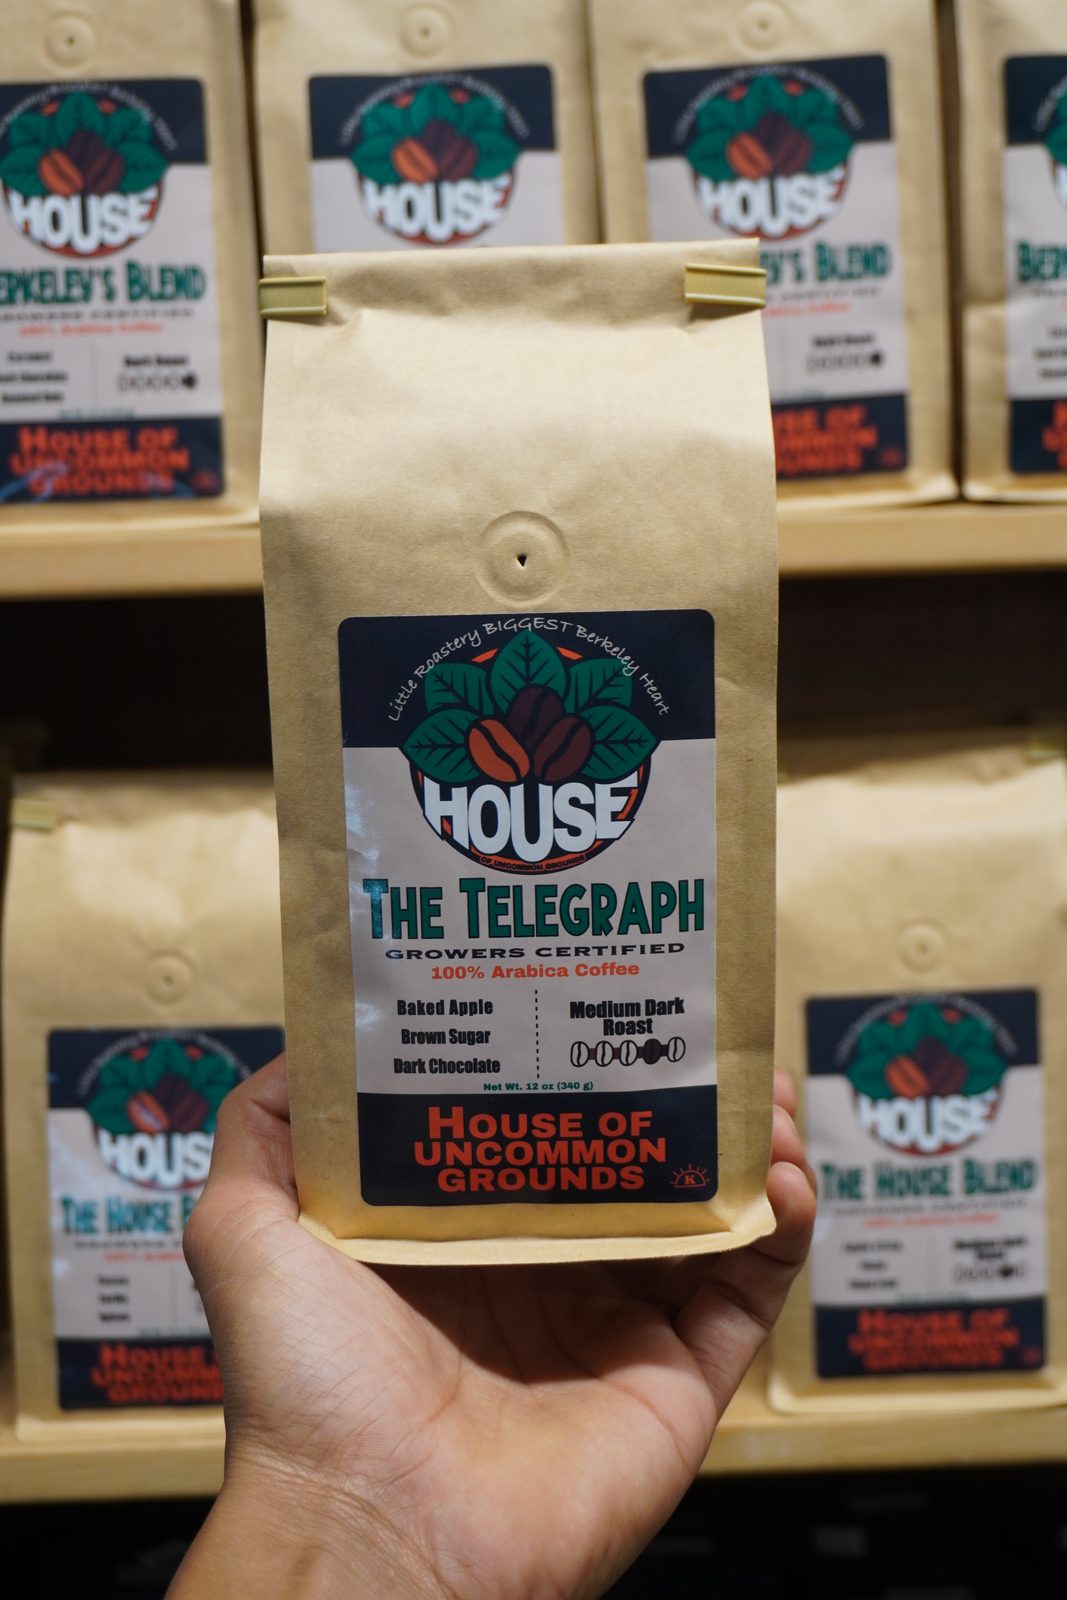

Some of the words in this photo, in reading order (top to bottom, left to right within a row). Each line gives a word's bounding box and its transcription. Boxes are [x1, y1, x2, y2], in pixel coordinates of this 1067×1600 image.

[363, 174, 511, 241] HOUSE
[698, 165, 845, 235] HOUSE
[8, 186, 158, 254] HOUSE
[0, 266, 115, 306] ERKELEY'S
[126, 259, 206, 302] BLEND
[388, 679, 418, 721] Little
[414, 629, 481, 678] Roastery
[482, 617, 574, 635] BIGGEST
[576, 624, 640, 676] Berkeley
[640, 672, 670, 715] Heart
[423, 771, 639, 862] HOUSE
[362, 878, 445, 939] THE
[459, 877, 705, 939] TELEGRAPH
[385, 947, 526, 960] GROWERS
[535, 942, 685, 957] CERTIFIED
[431, 965, 485, 980] 100%
[491, 962, 569, 979] Arabica
[575, 962, 640, 977] Coffee
[397, 1000, 445, 1015] Baked
[449, 1000, 493, 1016] Apple
[570, 1000, 641, 1019] Medium
[645, 997, 685, 1016] Dark
[401, 1030, 446, 1045] Brown
[449, 1029, 490, 1046] Sugar
[603, 1018, 653, 1036] Roast
[393, 1058, 427, 1074] Dark
[428, 1058, 501, 1074] Chocolate
[483, 1082, 502, 1091] Net
[505, 1082, 523, 1091] Wt.
[526, 1082, 539, 1091] 12
[542, 1083, 554, 1091] oz
[557, 1081, 581, 1091] (340
[583, 1082, 594, 1092] g)
[428, 1106, 584, 1139] HOUSE
[598, 1110, 653, 1137] OF
[857, 1088, 999, 1151] HOUSE
[99, 1128, 214, 1188] HOUS
[414, 1137, 667, 1166] UNCOMMON
[437, 1165, 645, 1192] GROUNDS
